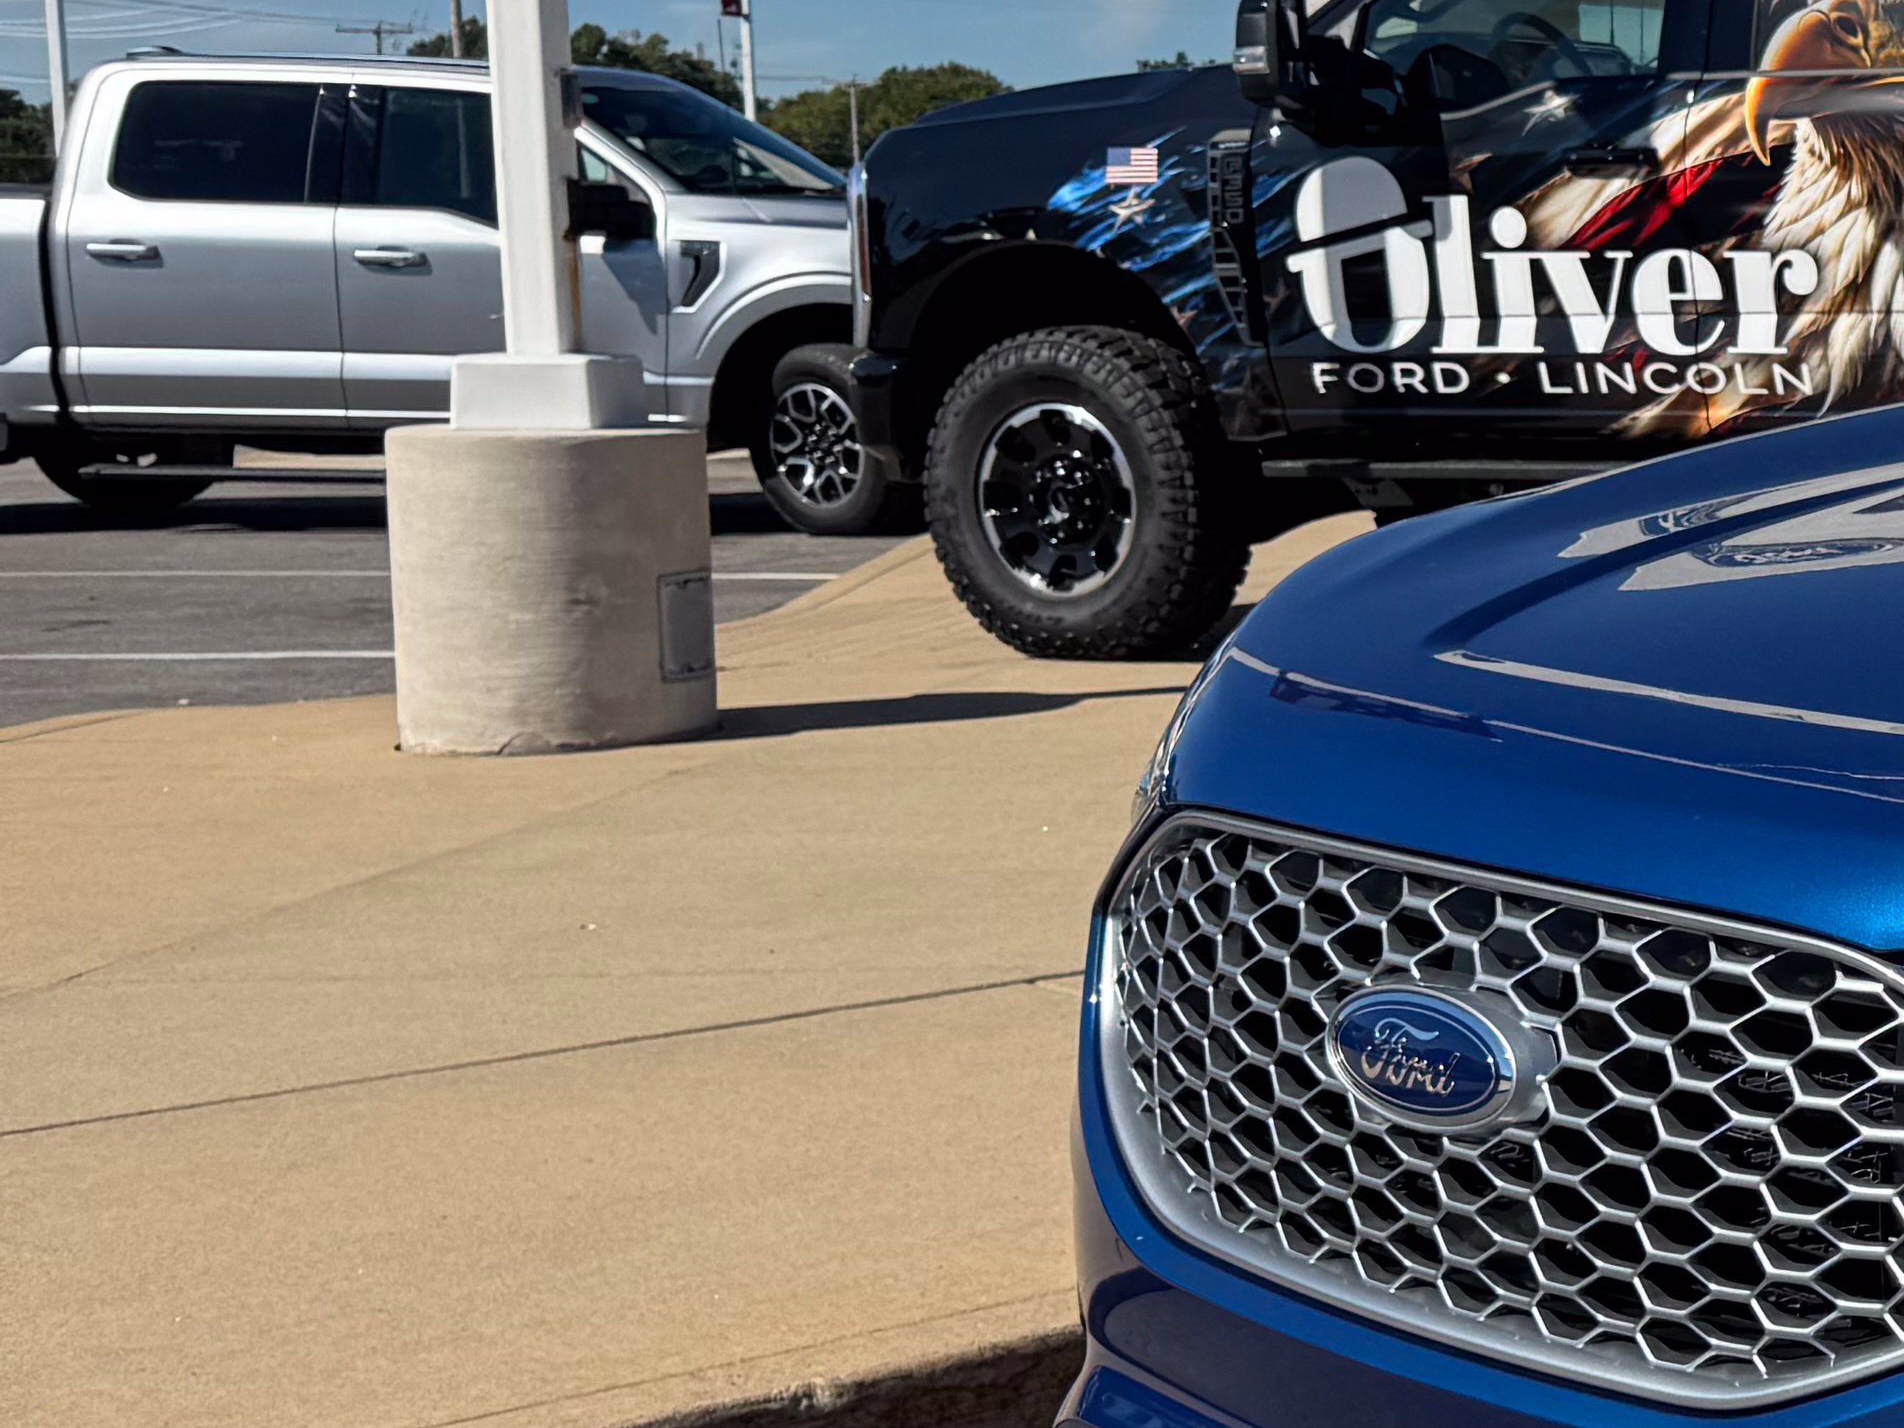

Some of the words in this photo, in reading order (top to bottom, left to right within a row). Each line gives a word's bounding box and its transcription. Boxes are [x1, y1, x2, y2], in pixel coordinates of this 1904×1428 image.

[1284, 155, 1818, 356] Oliver
[1312, 361, 1470, 395] FORD
[1538, 361, 1815, 396] LINCOLN
[1361, 1017, 1461, 1098] Ford
